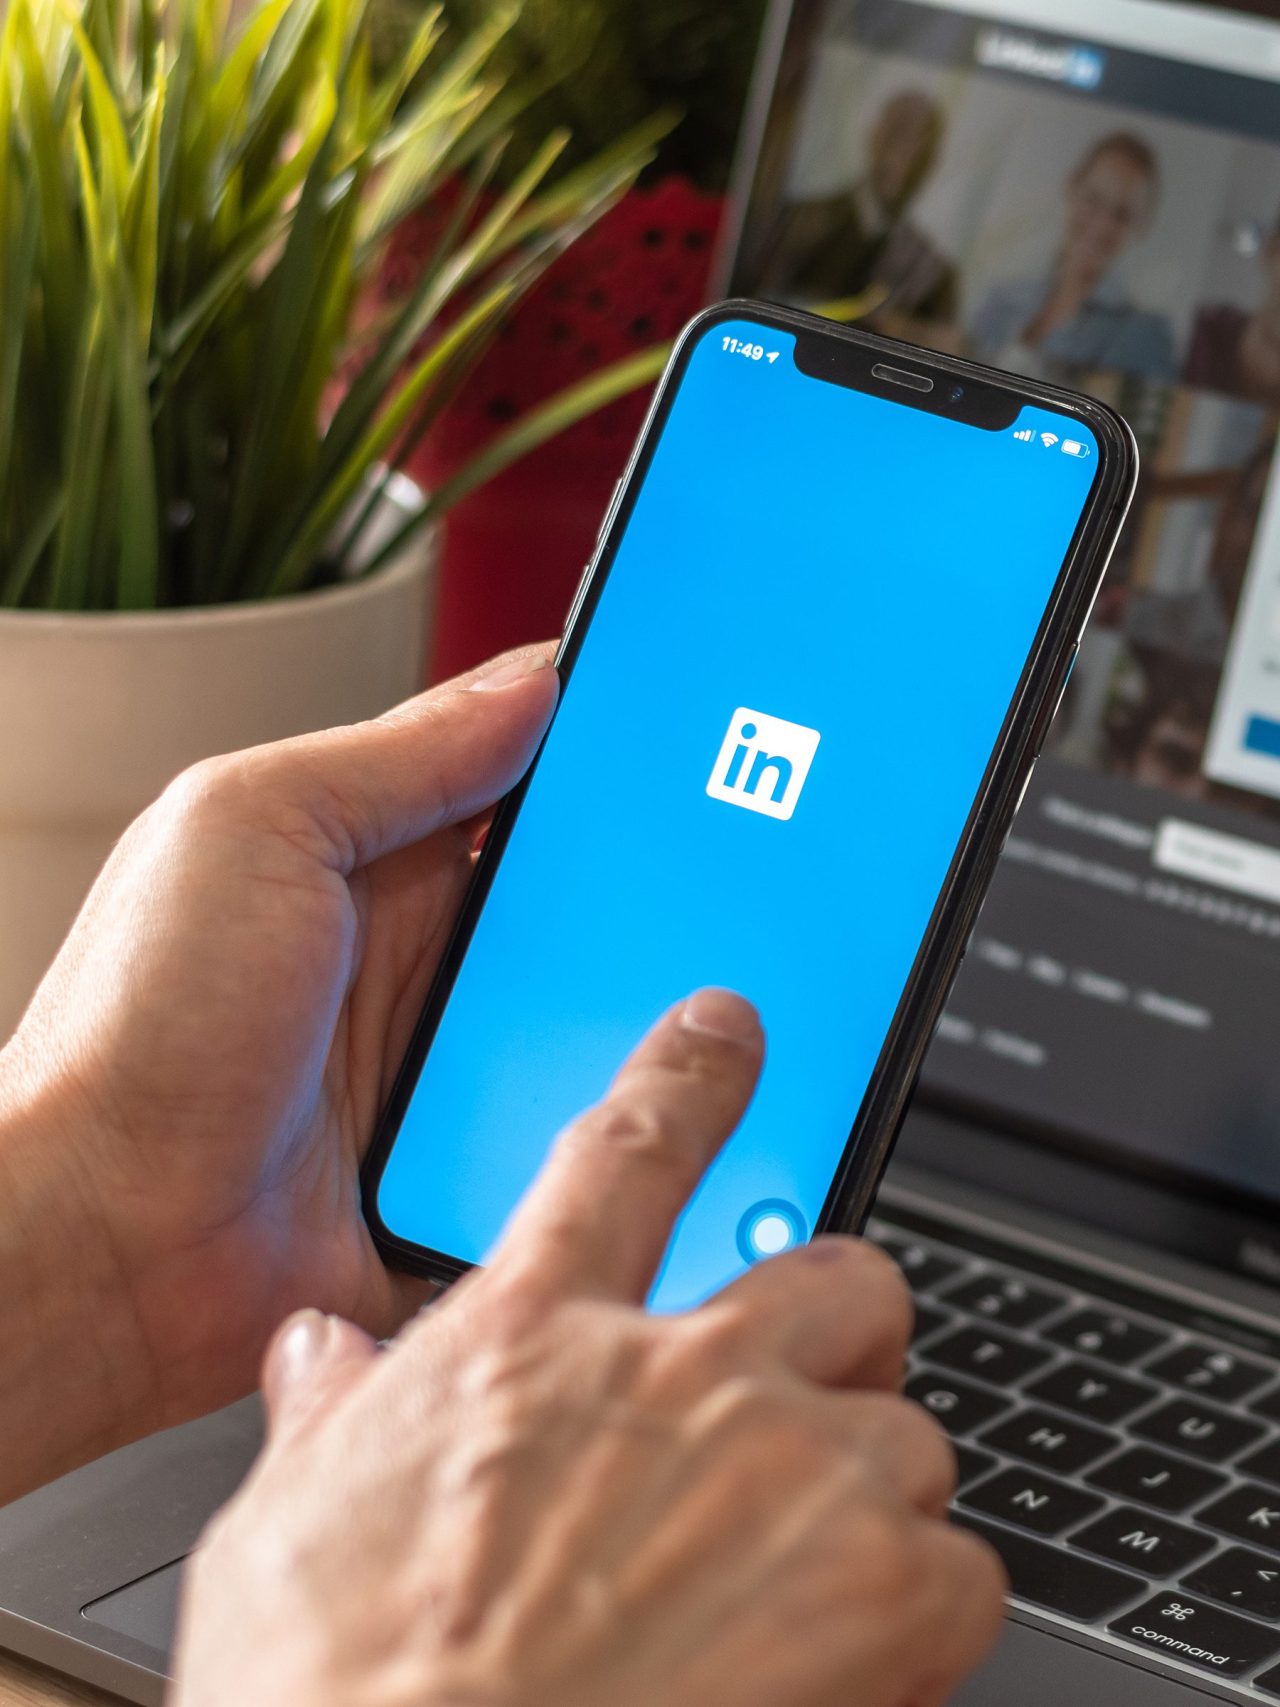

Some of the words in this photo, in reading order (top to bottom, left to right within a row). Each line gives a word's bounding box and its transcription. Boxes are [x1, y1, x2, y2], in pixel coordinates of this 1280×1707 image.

[722, 336, 764, 361] 11:49
[719, 720, 796, 805] in
[923, 1389, 960, 1412] G
[1027, 1425, 1068, 1450] H
[1178, 1415, 1216, 1440] U
[1141, 1471, 1171, 1489] J
[1012, 1488, 1050, 1510] N
[1119, 1530, 1161, 1553] M
[1131, 1626, 1231, 1665] command
